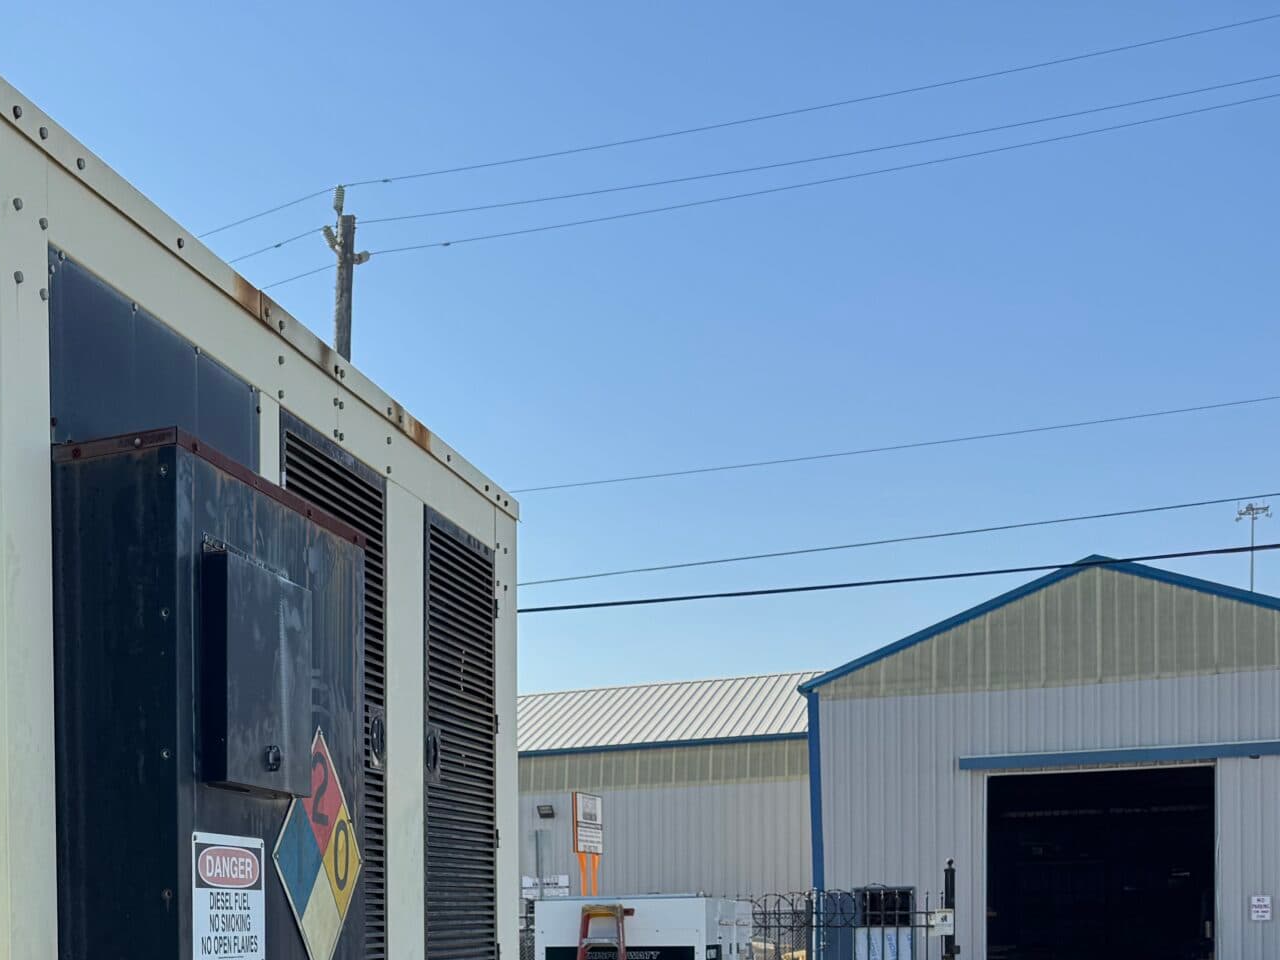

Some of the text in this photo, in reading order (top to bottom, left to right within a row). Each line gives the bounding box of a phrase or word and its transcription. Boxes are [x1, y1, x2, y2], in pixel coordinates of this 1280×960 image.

[311, 751, 329, 827] 2
[333, 819, 349, 891] 0
[206, 855, 253, 879] DANGER
[209, 892, 251, 911] DIESEL FUEL
[209, 914, 251, 932] NO SMOKING
[201, 935, 258, 955] NO OPEN FLAMES
